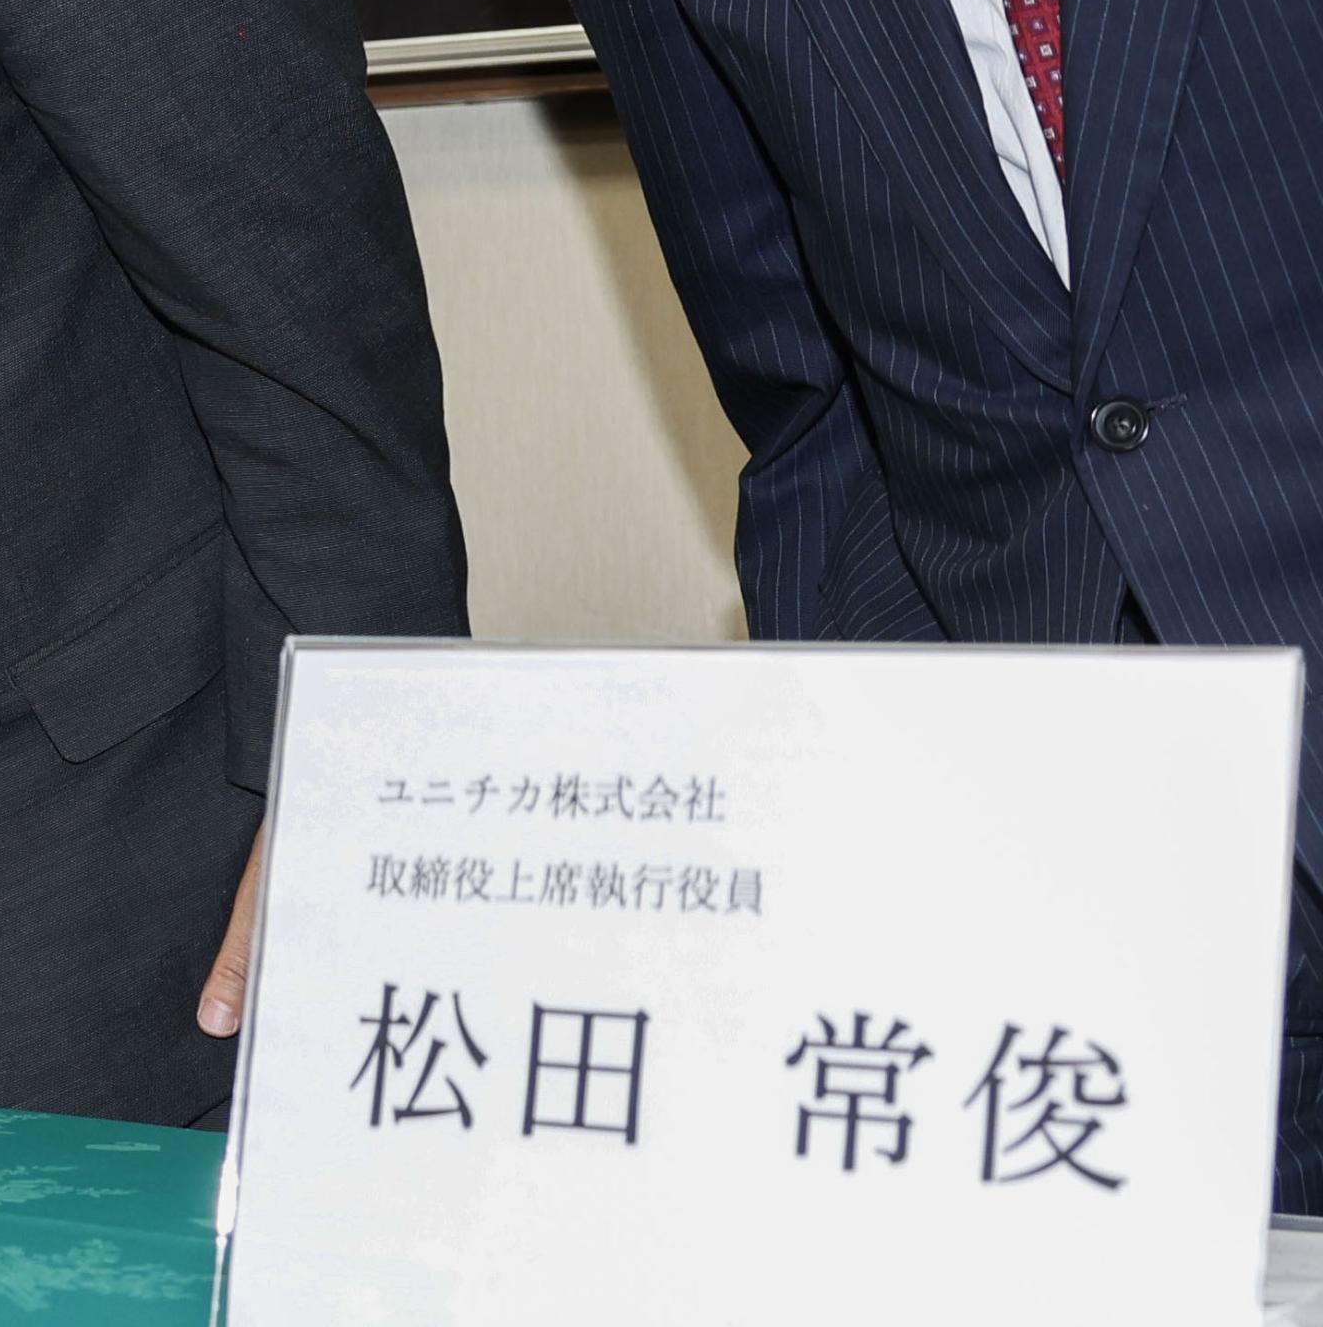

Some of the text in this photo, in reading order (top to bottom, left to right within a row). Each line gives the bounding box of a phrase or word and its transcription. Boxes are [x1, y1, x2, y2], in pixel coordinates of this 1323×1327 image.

[377, 773, 726, 824] ユニチカ株式会社
[366, 854, 763, 915] 取締役上席執行役員
[349, 982, 1129, 1192] 松田 常俊
